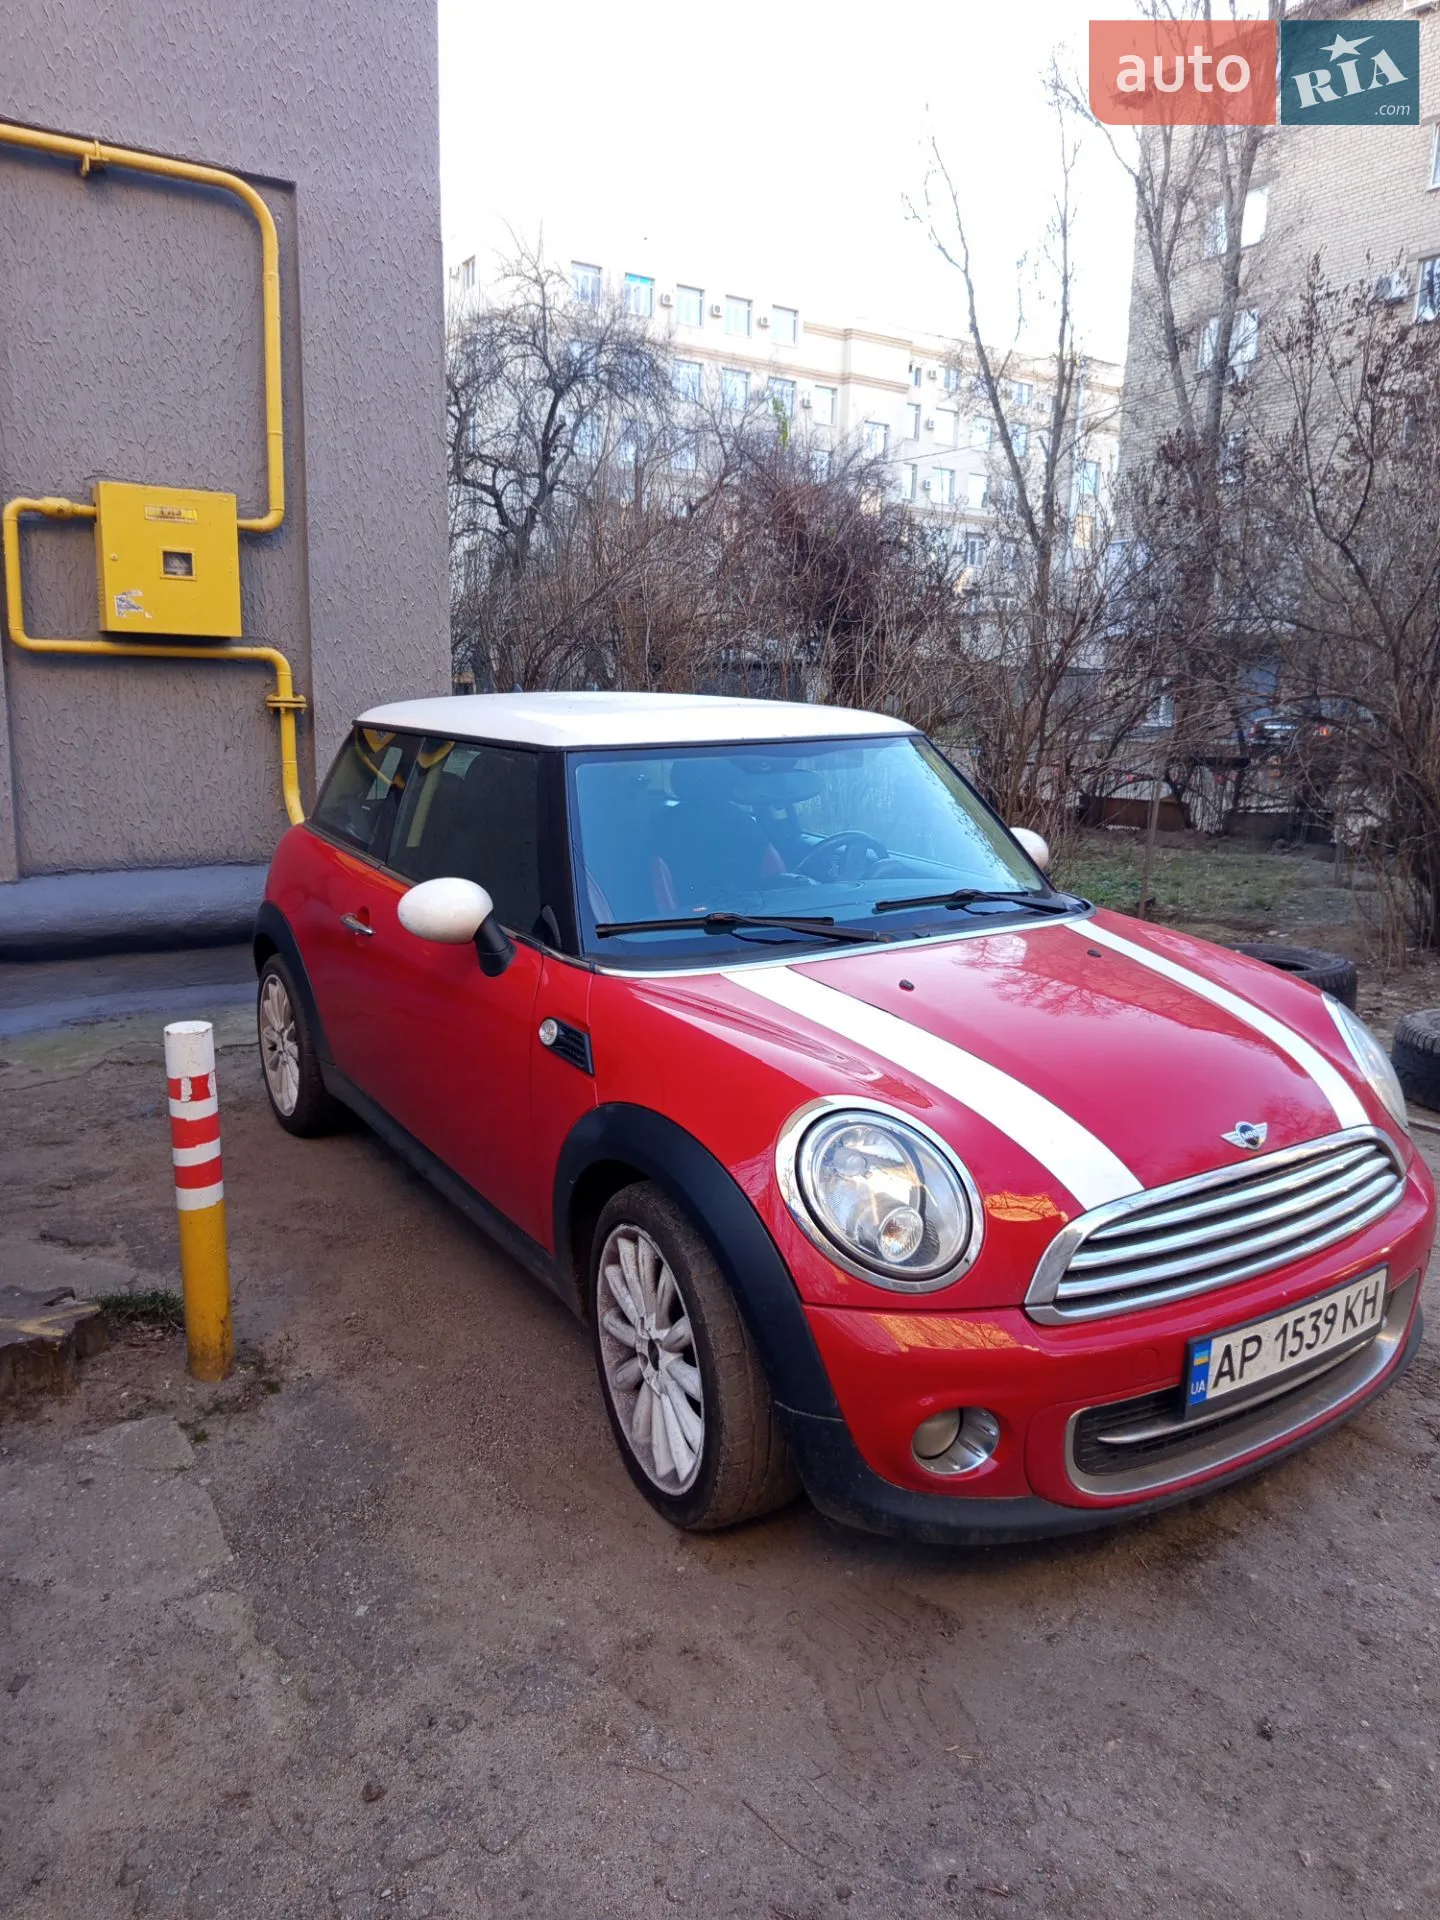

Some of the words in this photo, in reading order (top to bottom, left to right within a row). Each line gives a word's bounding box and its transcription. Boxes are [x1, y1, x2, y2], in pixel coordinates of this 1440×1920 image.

[1211, 1334, 1262, 1390] AP
[1274, 1302, 1338, 1363] 1539
[1341, 1280, 1380, 1334] KH
[1190, 1379, 1206, 1395] UA
